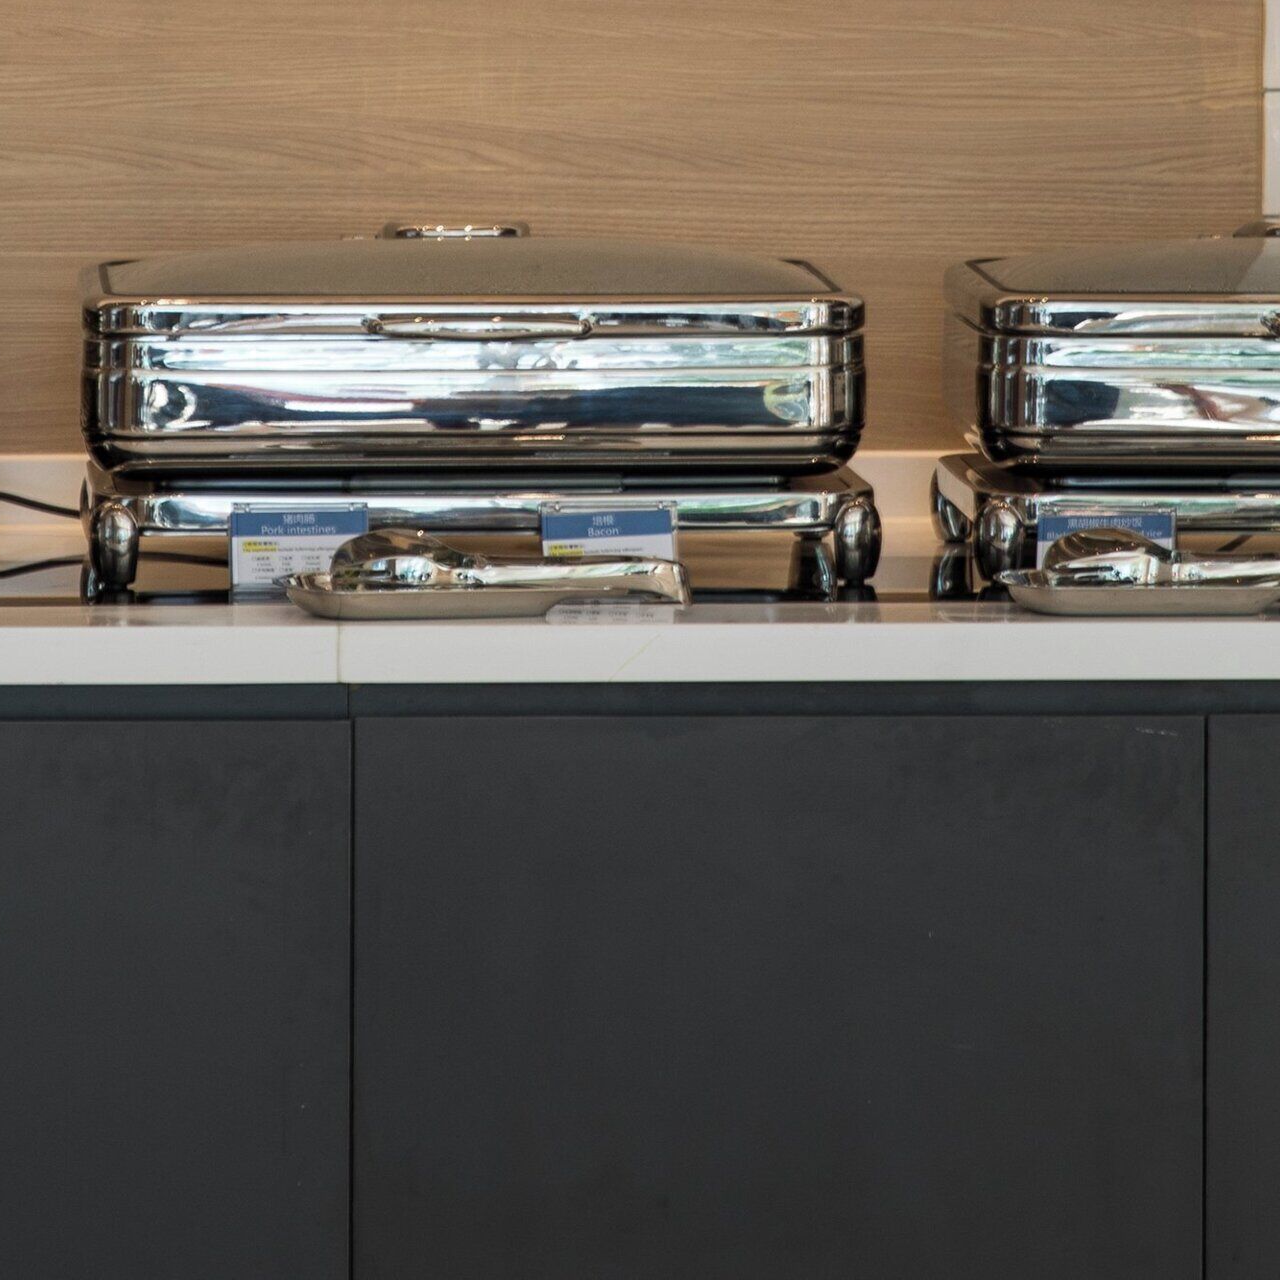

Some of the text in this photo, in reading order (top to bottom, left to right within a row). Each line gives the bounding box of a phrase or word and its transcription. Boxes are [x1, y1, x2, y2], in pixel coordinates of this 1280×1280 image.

[261, 525, 336, 535] Pork intestines
[587, 527, 619, 537] Bacon
